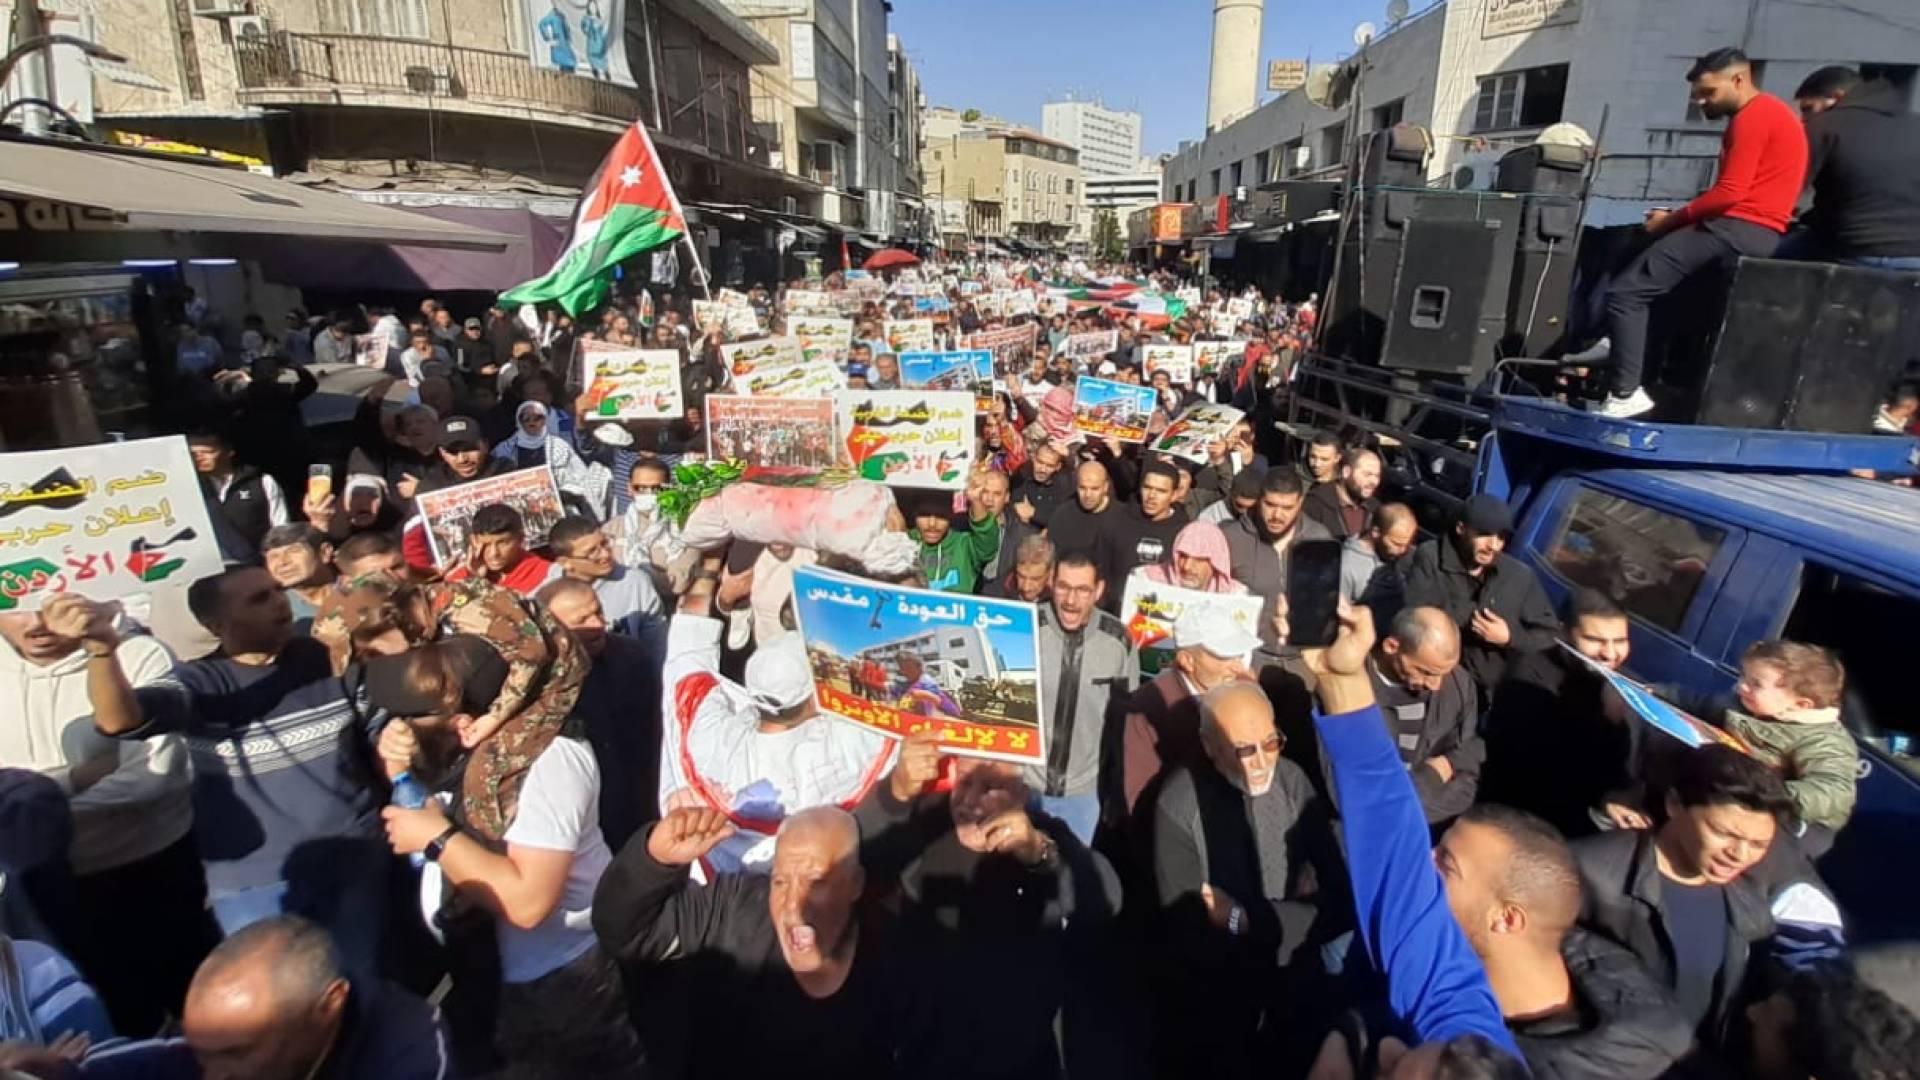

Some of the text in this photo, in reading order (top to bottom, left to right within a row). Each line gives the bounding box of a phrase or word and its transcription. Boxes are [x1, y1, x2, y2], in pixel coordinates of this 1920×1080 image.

[105, 468, 167, 496] ضم
[84, 497, 176, 536] إعلان
[1, 545, 115, 598] الأردن
[806, 585, 1013, 629] حق العودة مقدس
[822, 688, 903, 730] الأونروا
[1008, 731, 1030, 750] لا
